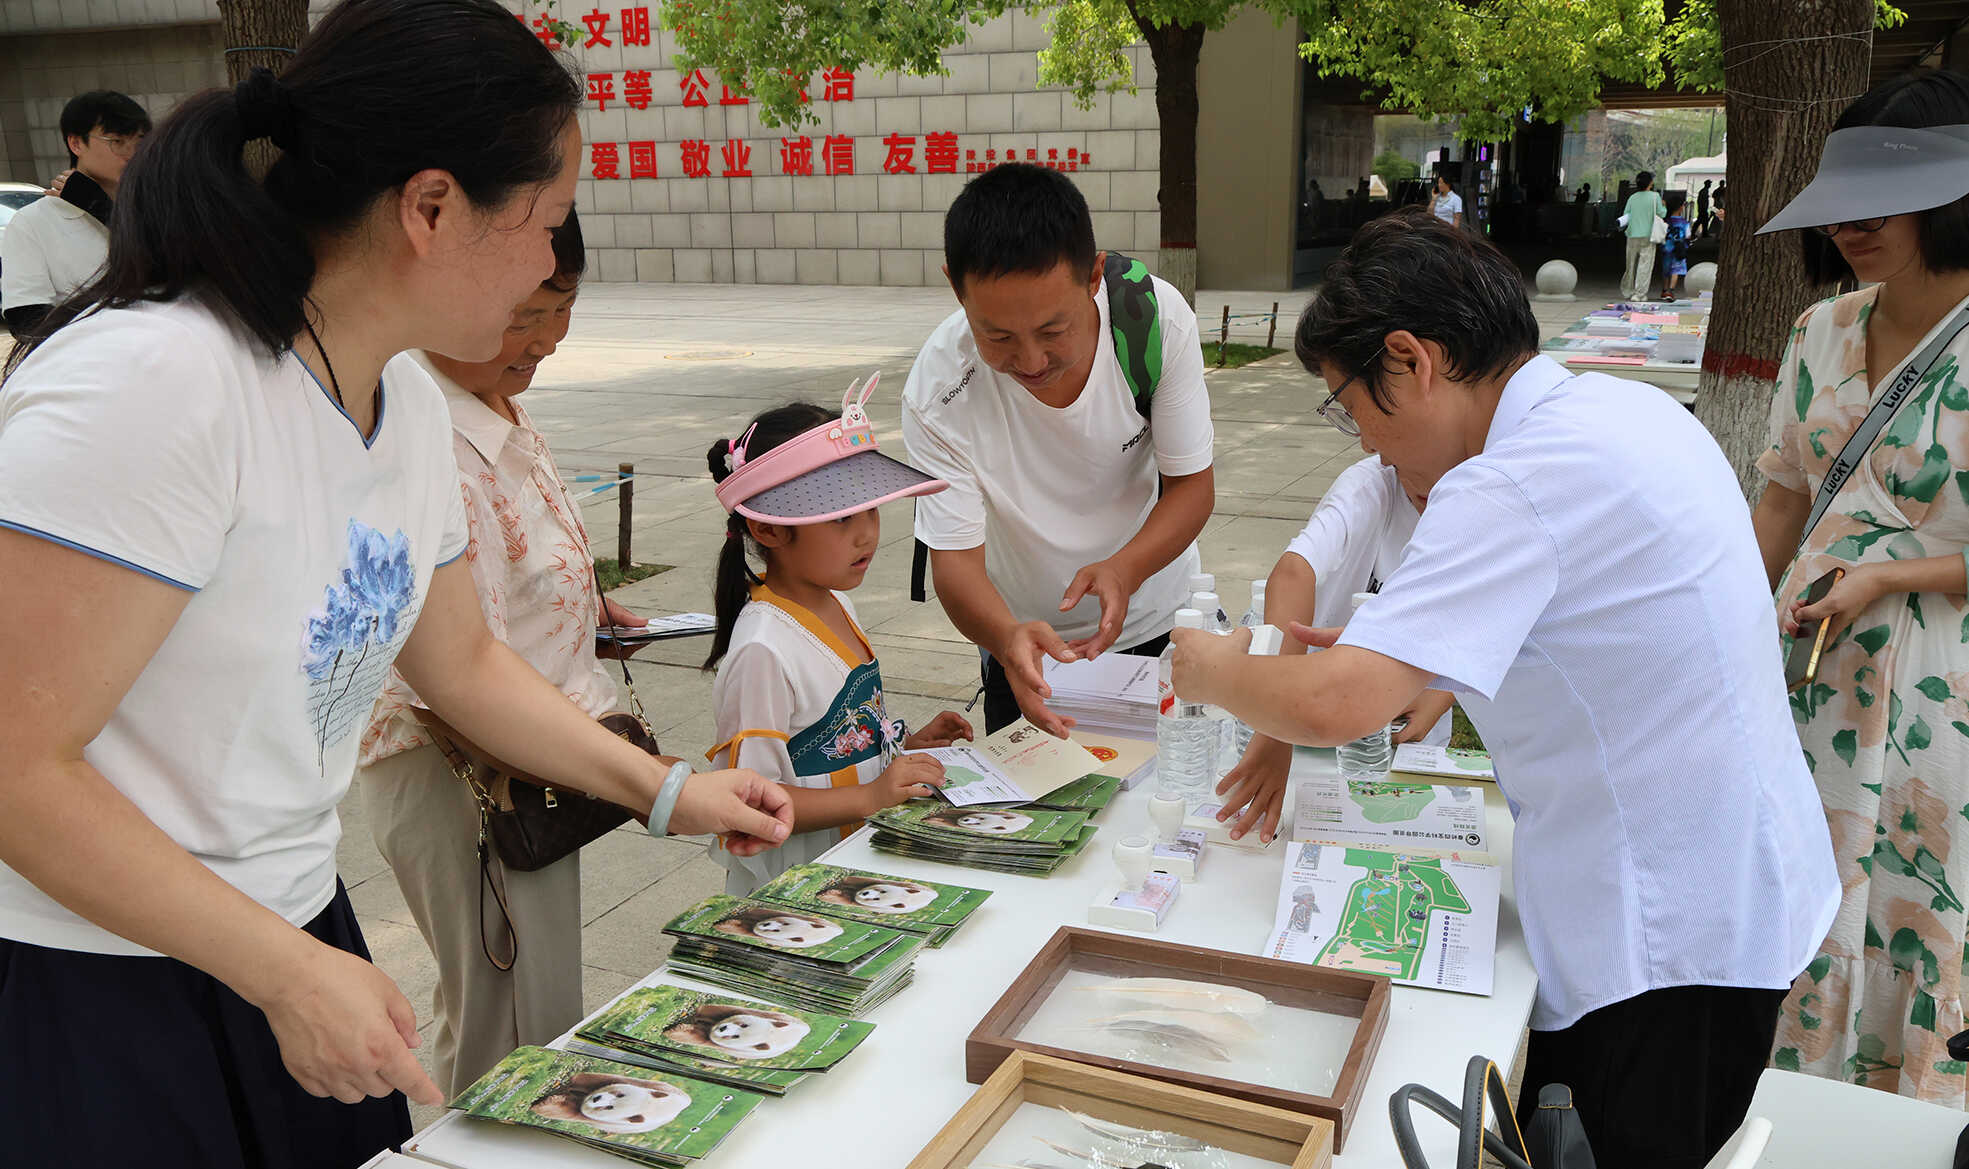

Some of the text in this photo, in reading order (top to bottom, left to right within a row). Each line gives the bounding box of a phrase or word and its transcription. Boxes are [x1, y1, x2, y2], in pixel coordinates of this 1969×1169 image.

[514, 12, 561, 51] 主
[581, 7, 651, 49] 文明
[587, 69, 653, 111] 平等
[781, 63, 856, 104] 治
[591, 131, 960, 180] 爱国 敬业 诚信 友善
[1881, 364, 1920, 410] LUCKY
[1823, 458, 1851, 495] LUCKY
